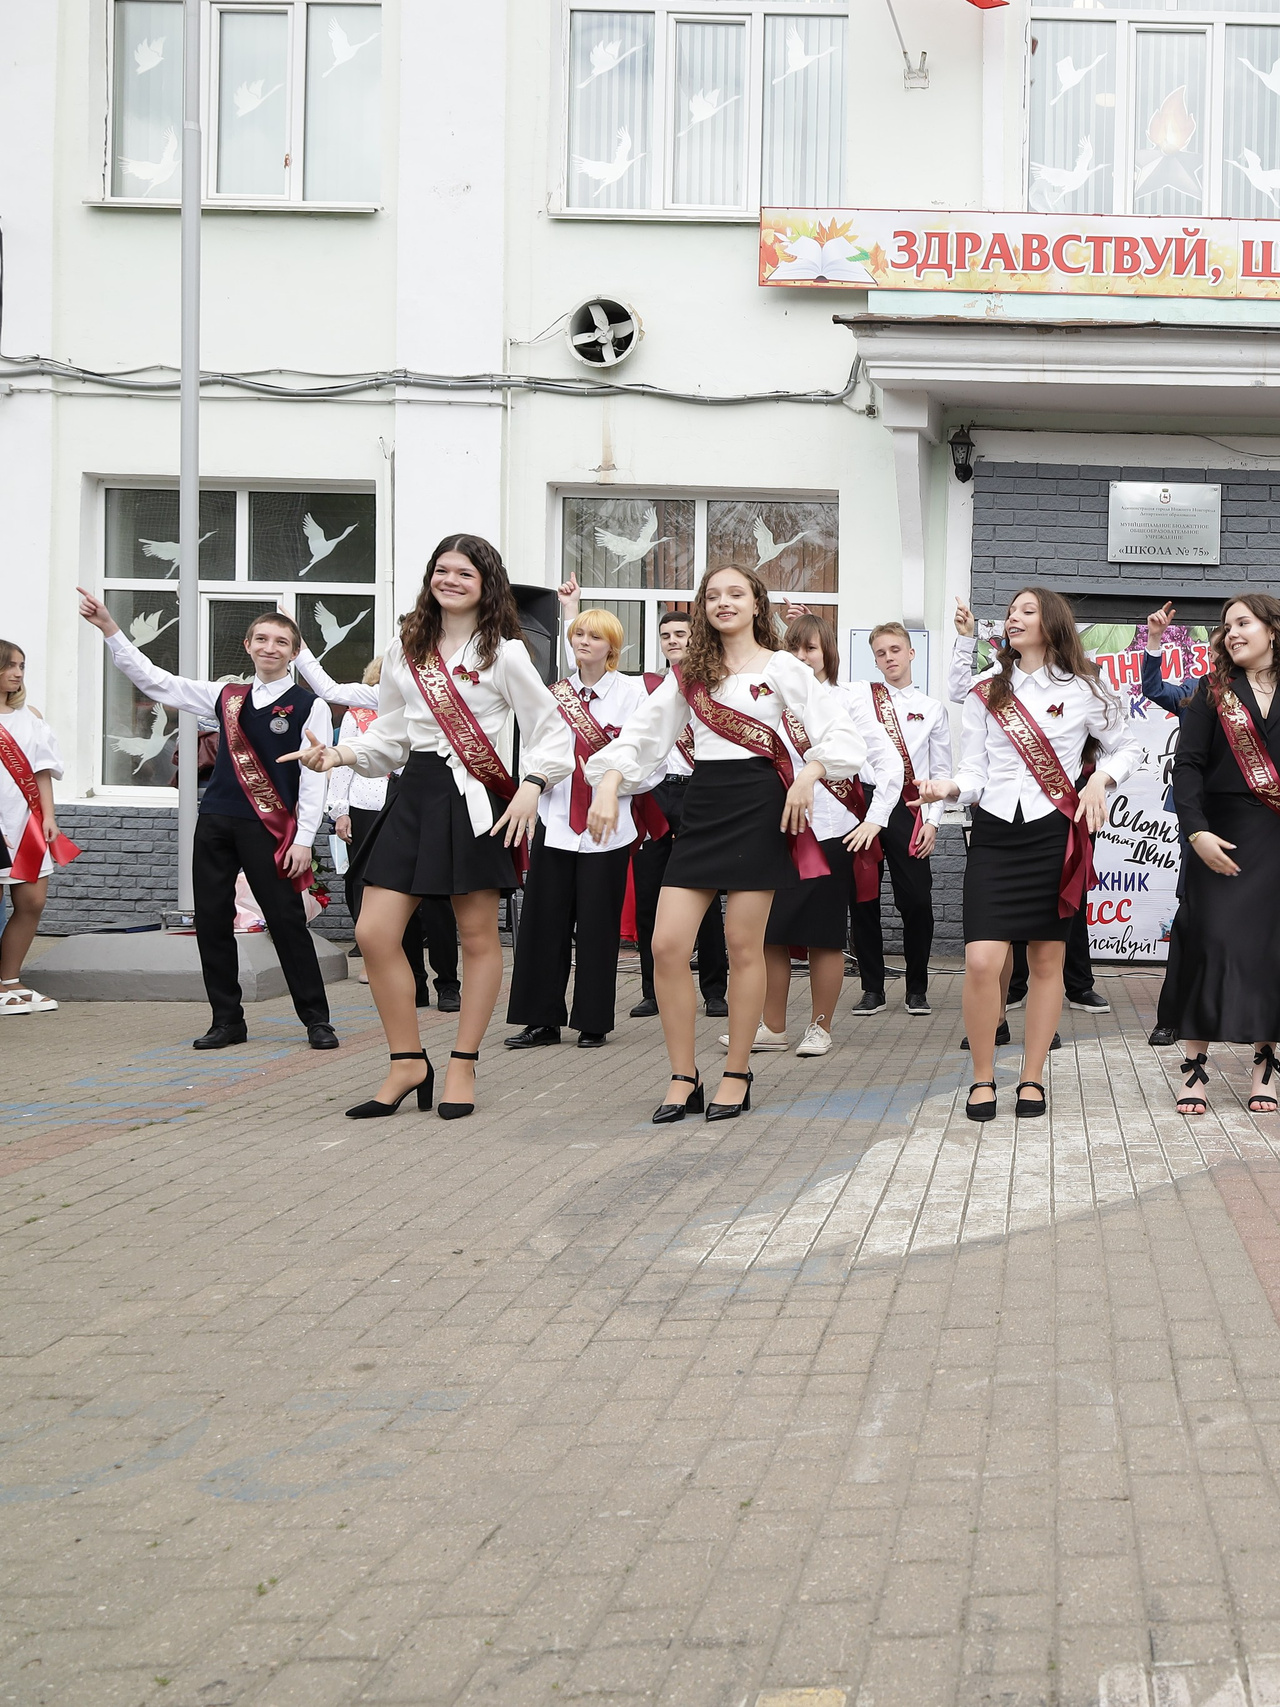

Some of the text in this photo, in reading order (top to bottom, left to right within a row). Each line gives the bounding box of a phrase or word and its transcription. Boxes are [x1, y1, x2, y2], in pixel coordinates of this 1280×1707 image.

[890, 227, 1222, 284] ЗДРАВСТВУЙ,
[1118, 545, 1210, 557] «ШКОЛА № 75»
[1000, 701, 1071, 800] ыпускник 2025
[247, 776, 282, 814] 2025
[1097, 831, 1136, 849] твой
[1090, 871, 1150, 892] КНИК
[1088, 925, 1157, 960] йствуй!
